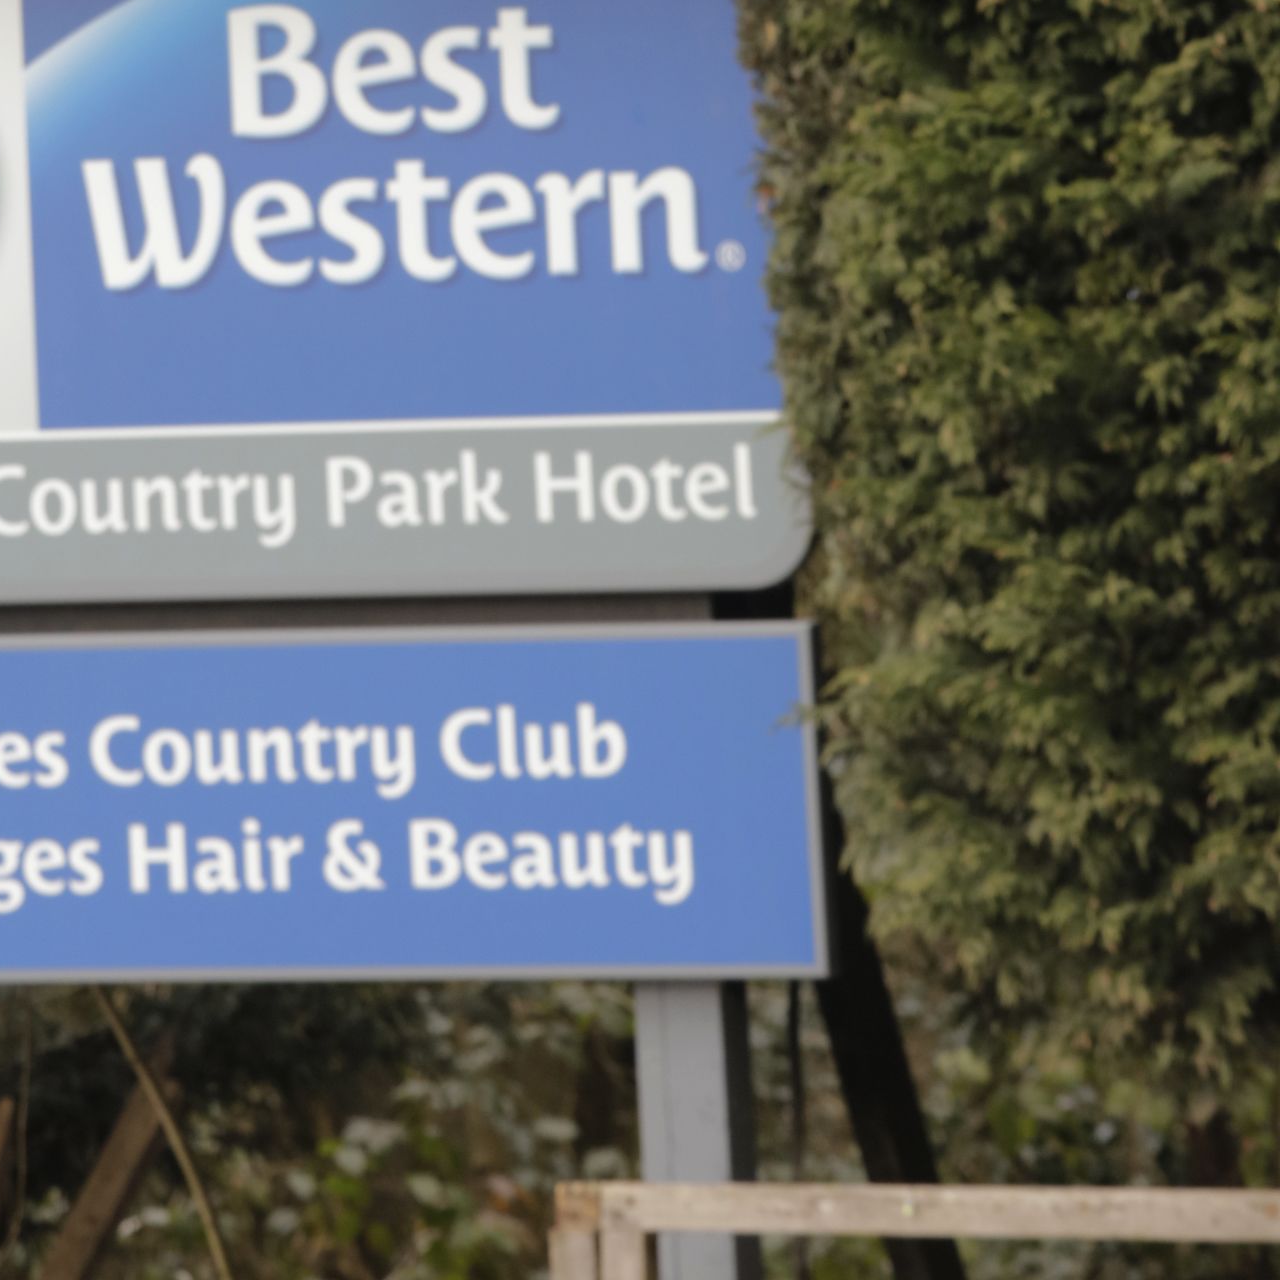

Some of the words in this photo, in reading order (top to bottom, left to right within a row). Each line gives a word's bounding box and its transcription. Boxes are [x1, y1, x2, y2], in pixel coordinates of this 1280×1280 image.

[226, 3, 560, 138] Best
[324, 447, 510, 529] Park
[532, 441, 757, 525] Hotel
[88, 713, 417, 801] Country
[438, 701, 628, 782] Club
[126, 816, 305, 895] Hair
[321, 817, 386, 893] &
[407, 816, 695, 906] Beauty
